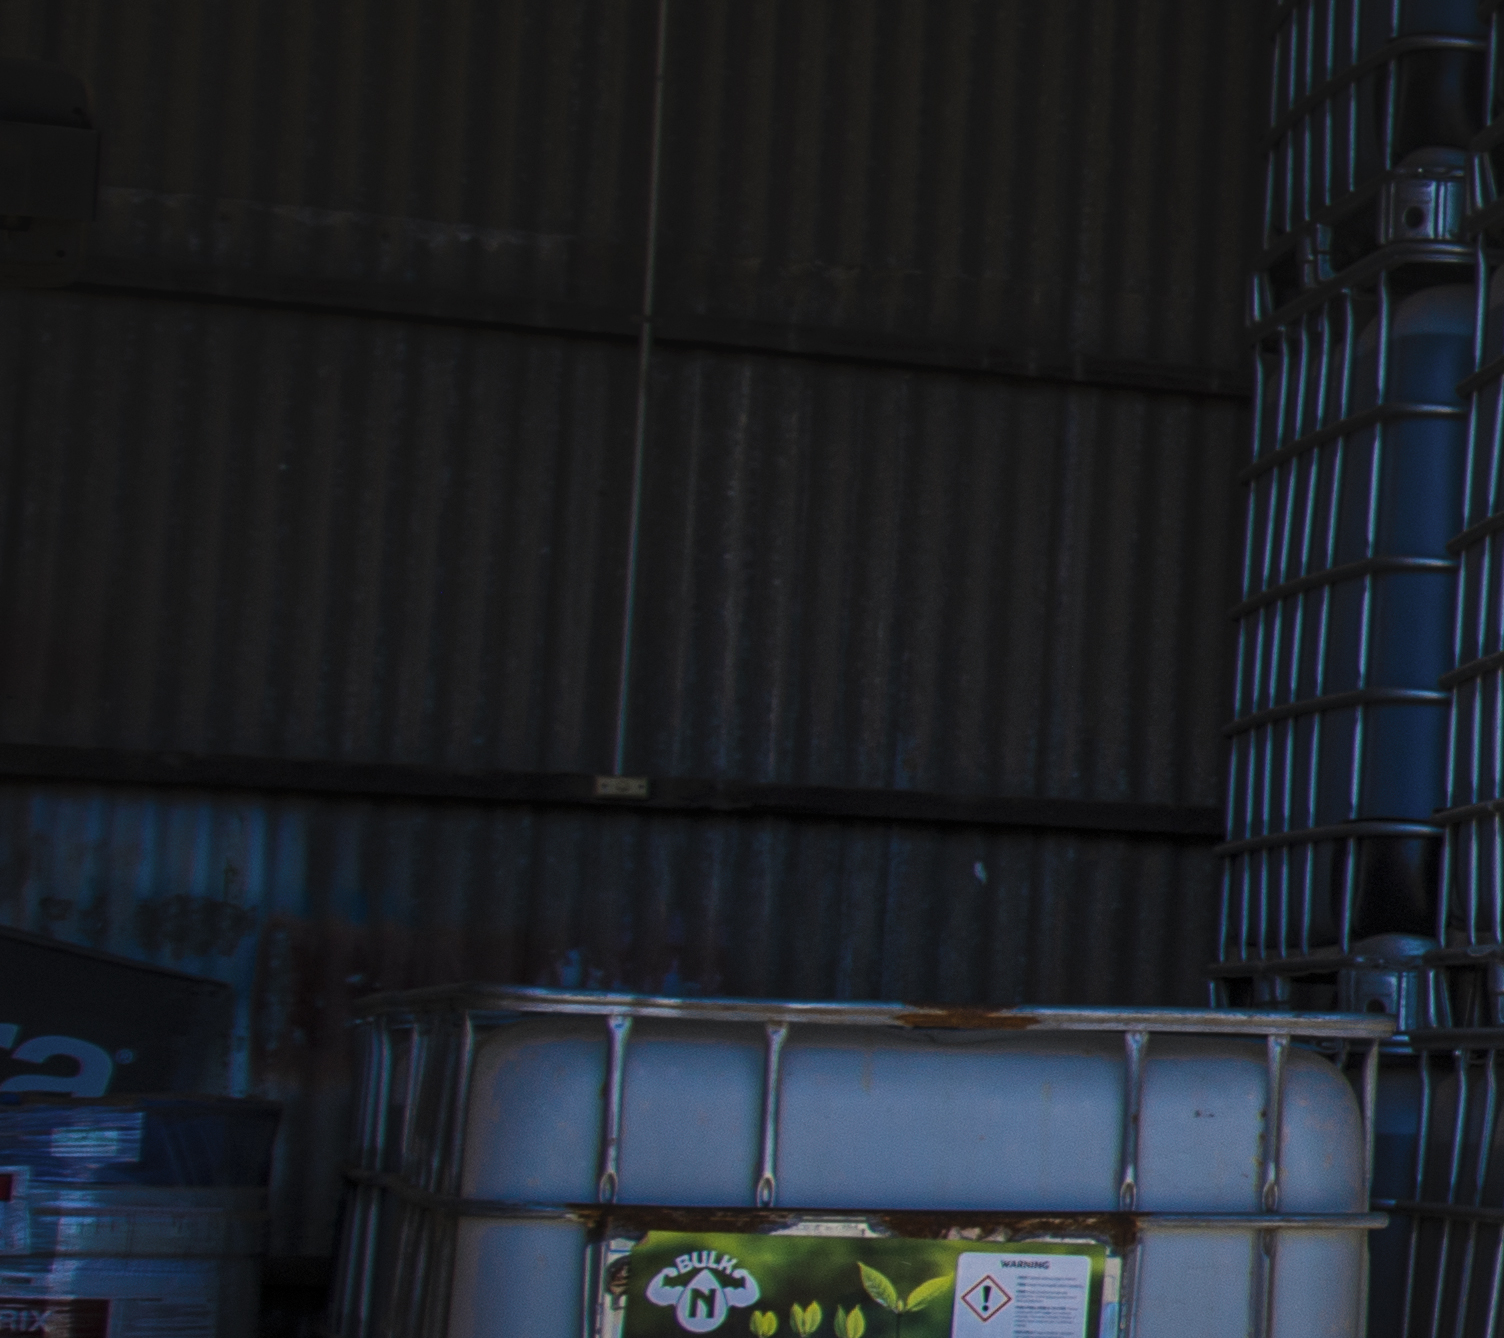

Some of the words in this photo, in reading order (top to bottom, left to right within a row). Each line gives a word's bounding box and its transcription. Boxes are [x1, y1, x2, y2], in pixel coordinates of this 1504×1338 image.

[675, 1250, 739, 1275] BULK
[1000, 1260, 1050, 1269] WARNING
[688, 1287, 718, 1319] N
